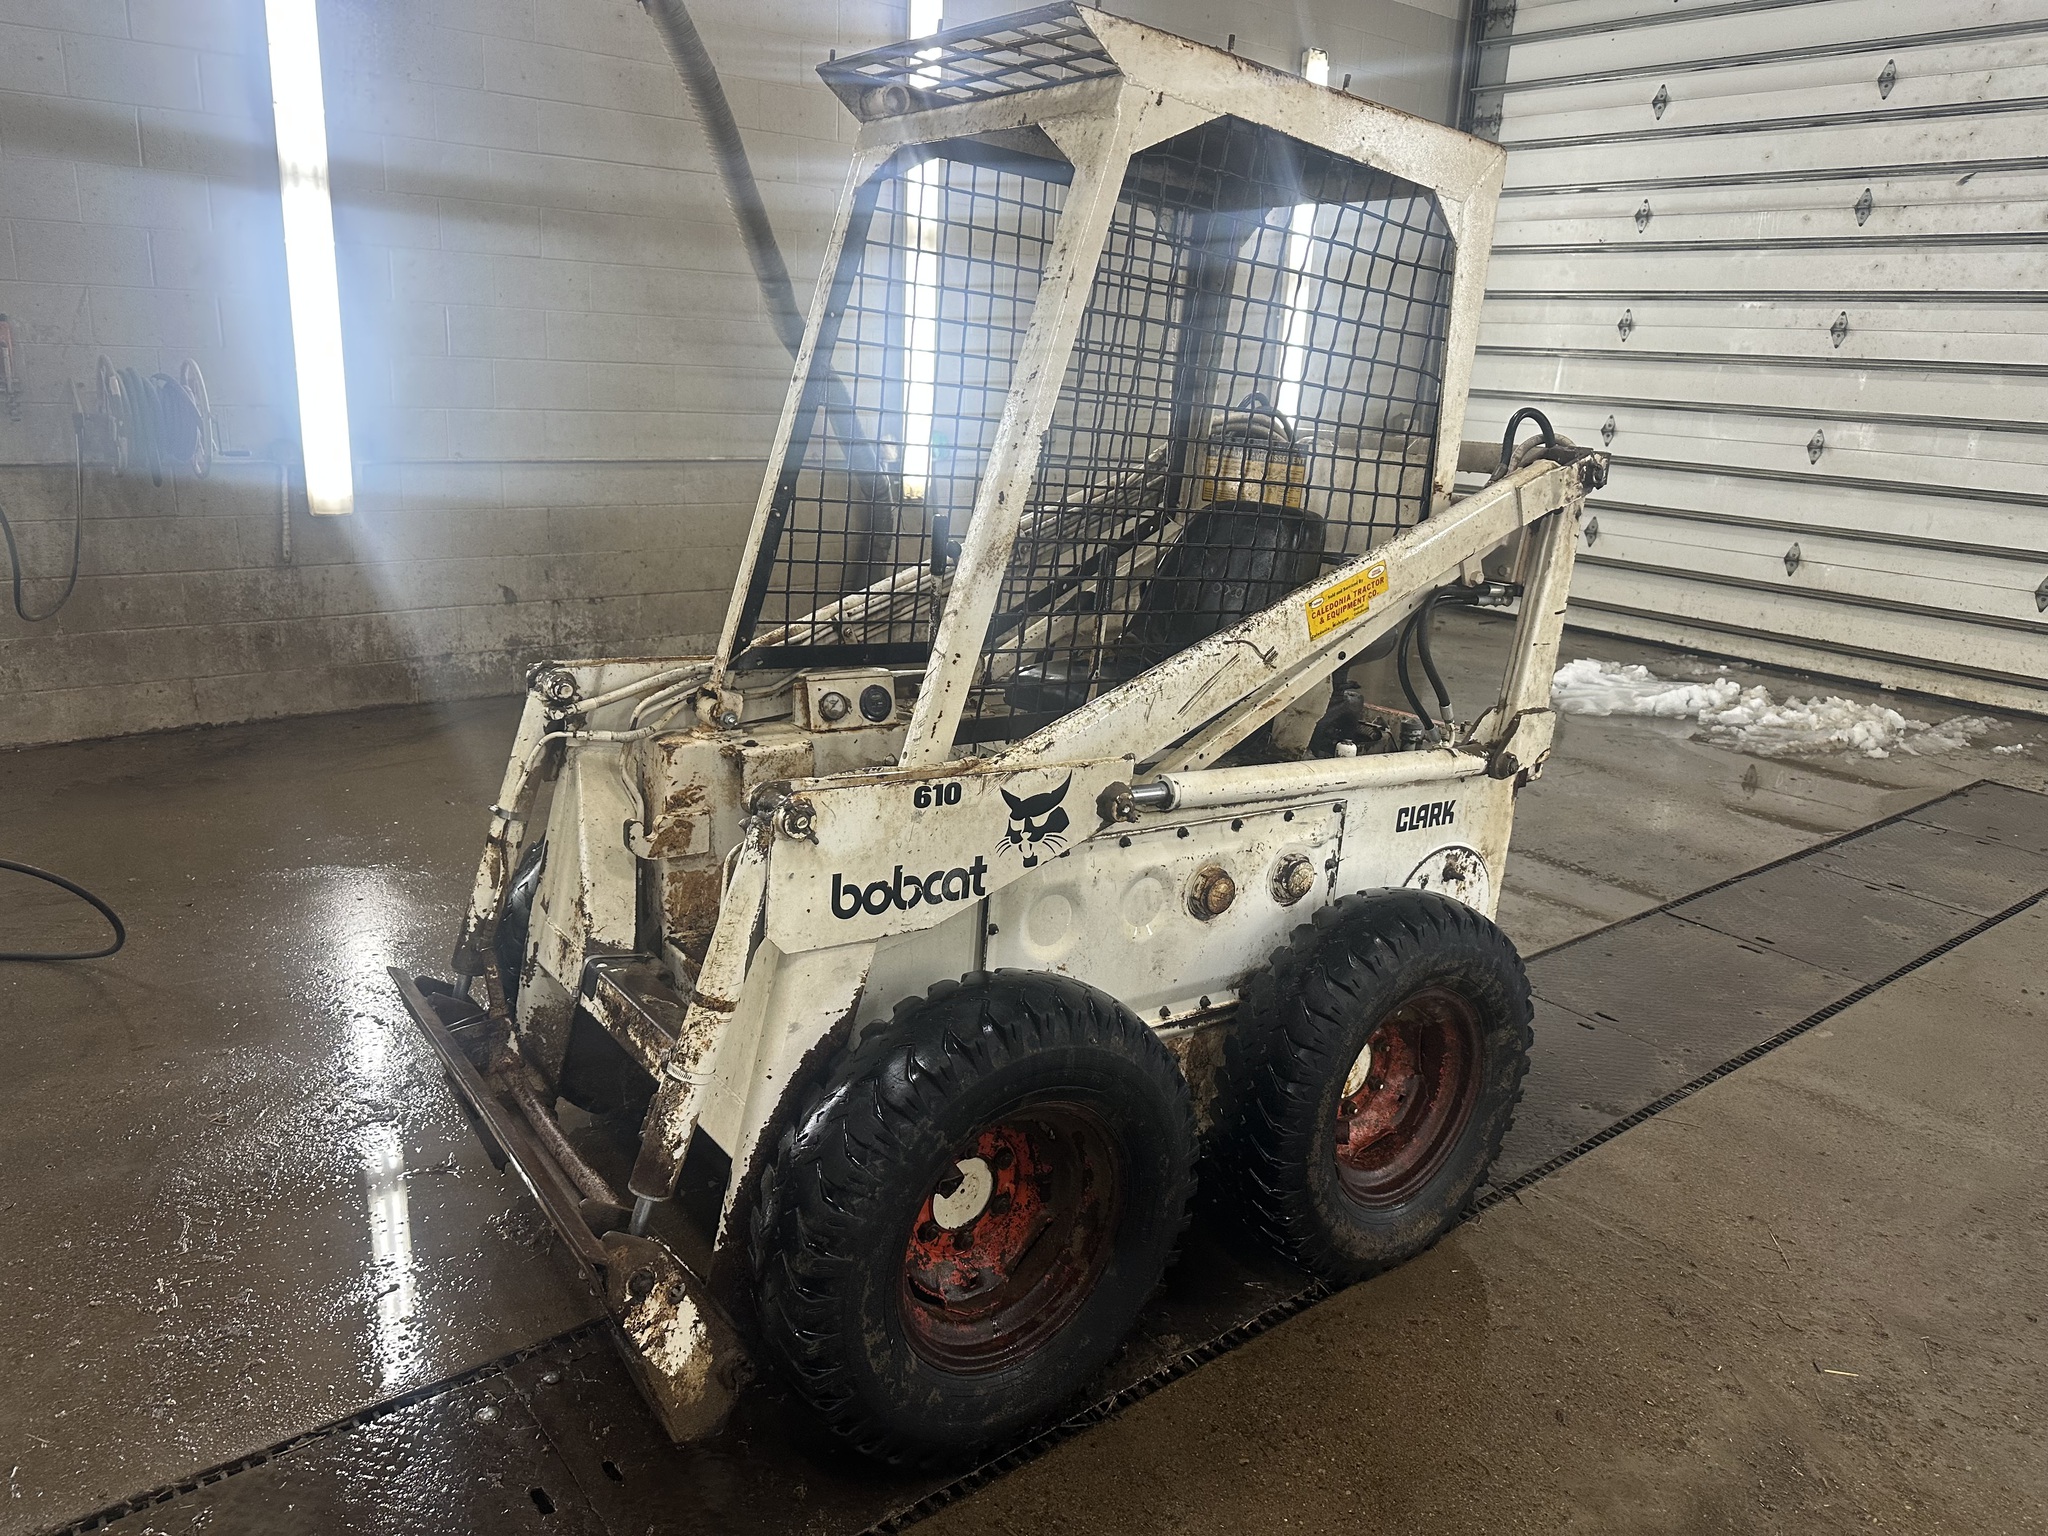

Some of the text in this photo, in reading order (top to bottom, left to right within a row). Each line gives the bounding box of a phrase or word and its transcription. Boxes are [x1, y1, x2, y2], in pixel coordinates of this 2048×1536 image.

[1311, 577, 1384, 619] CALEDONIA TRACTOR
[1319, 616, 1325, 625] &
[1326, 595, 1366, 621] EQUIPMENT
[1367, 589, 1378, 599] CO.
[913, 782, 962, 808] 610
[1396, 800, 1456, 833] CLARK
[831, 855, 988, 919] bobcat
